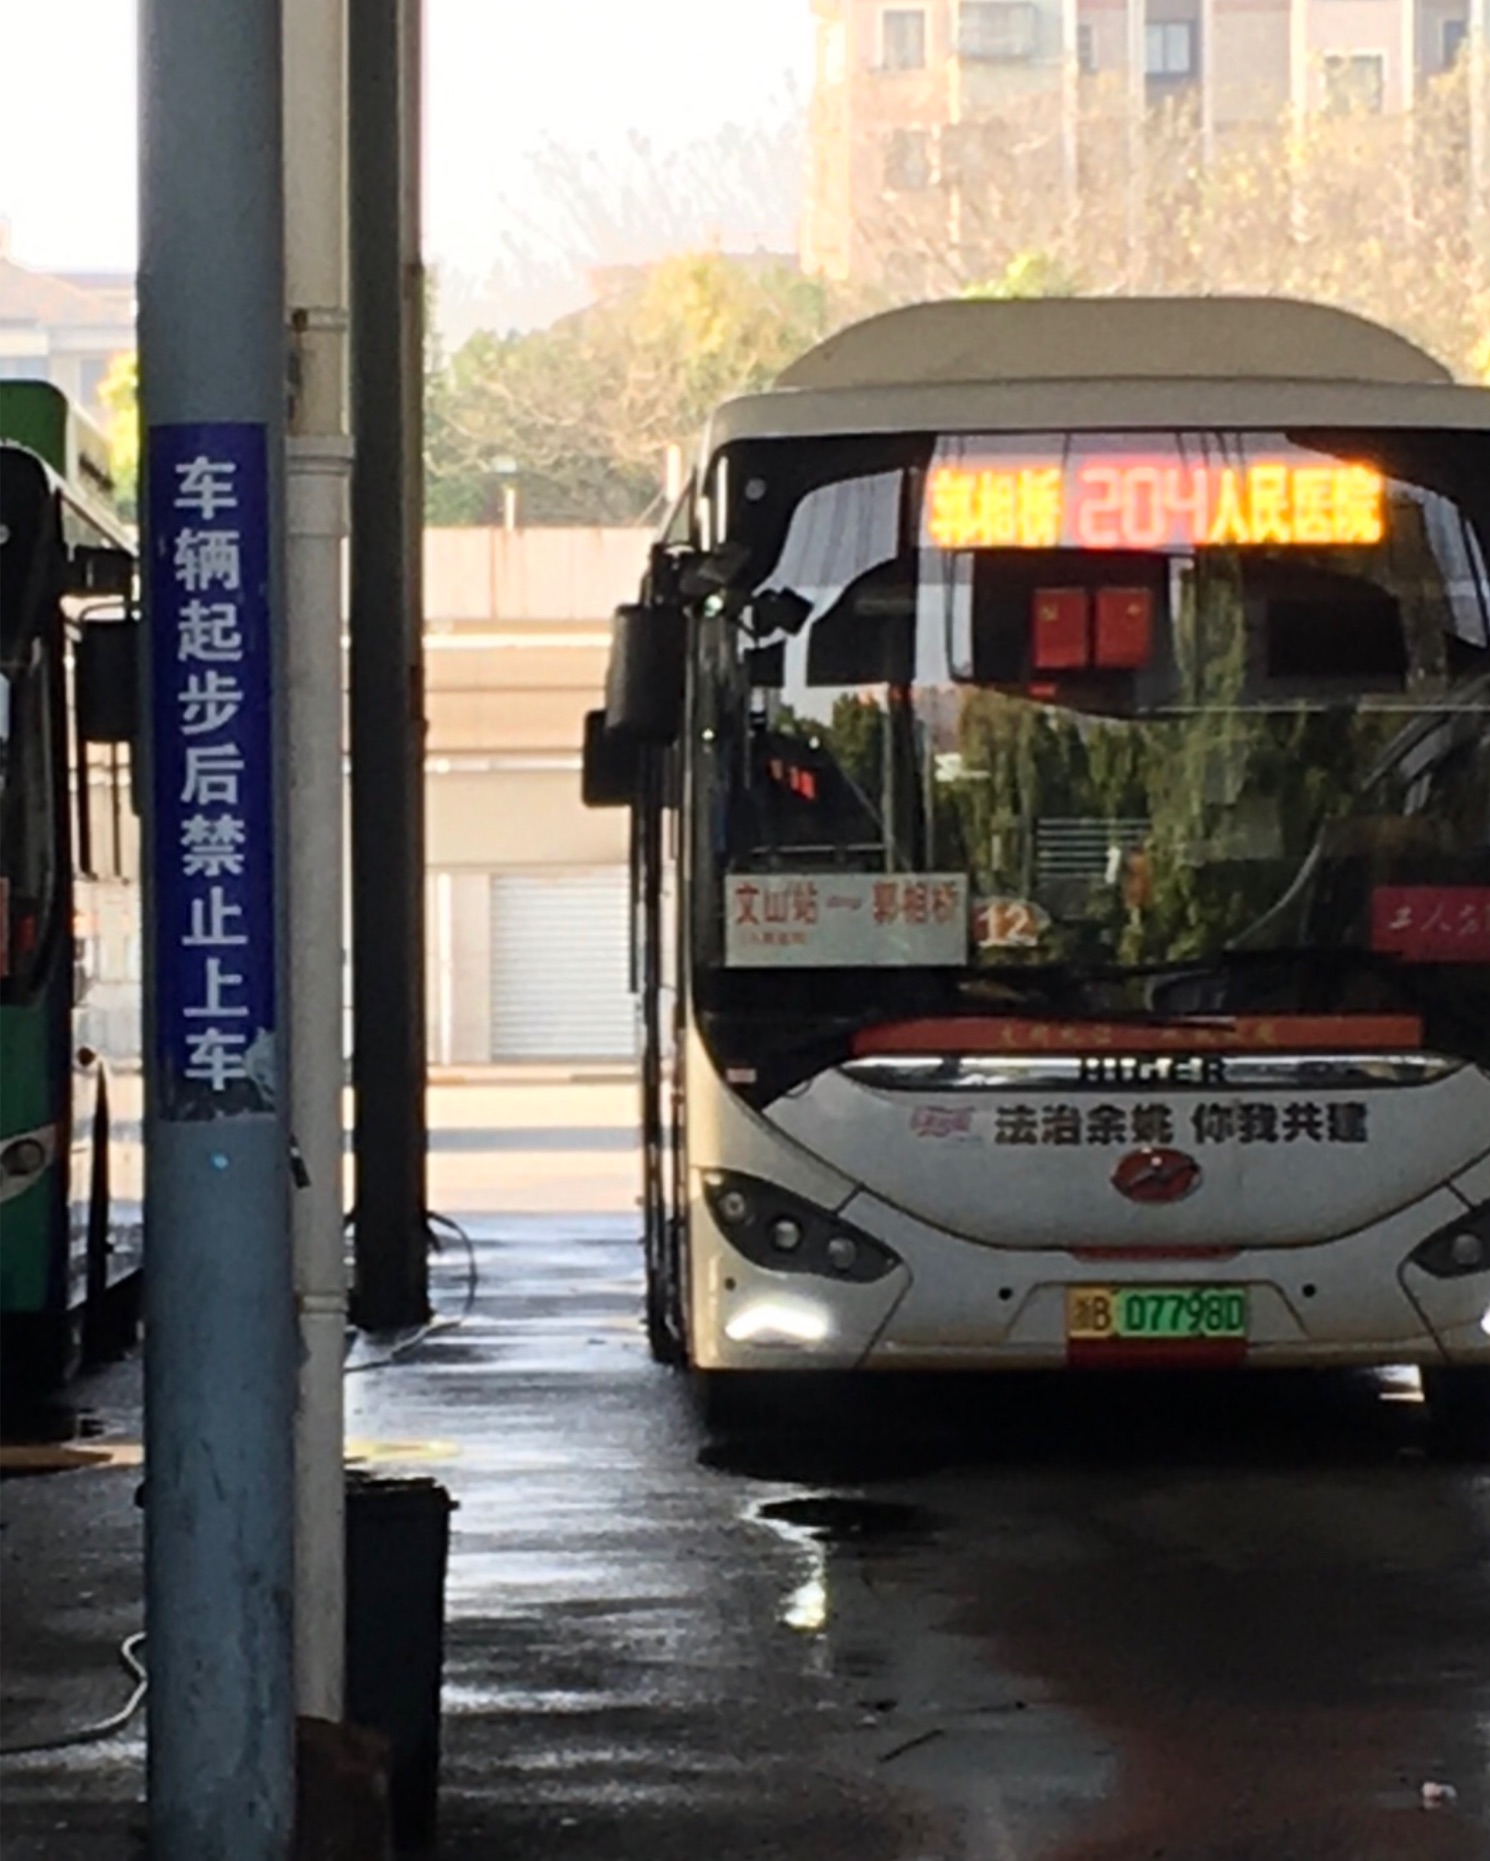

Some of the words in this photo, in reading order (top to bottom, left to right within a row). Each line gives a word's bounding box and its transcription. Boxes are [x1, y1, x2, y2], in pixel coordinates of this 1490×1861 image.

[1080, 465, 1208, 548] 204
[1210, 464, 1385, 544] 人民医院
[174, 455, 250, 1092] 车辆起步后禁止上车
[735, 882, 818, 926] 文山站
[976, 902, 1040, 947] 12
[995, 1103, 1174, 1145] 法治余姚
[1191, 1103, 1368, 1144] 你我共建
